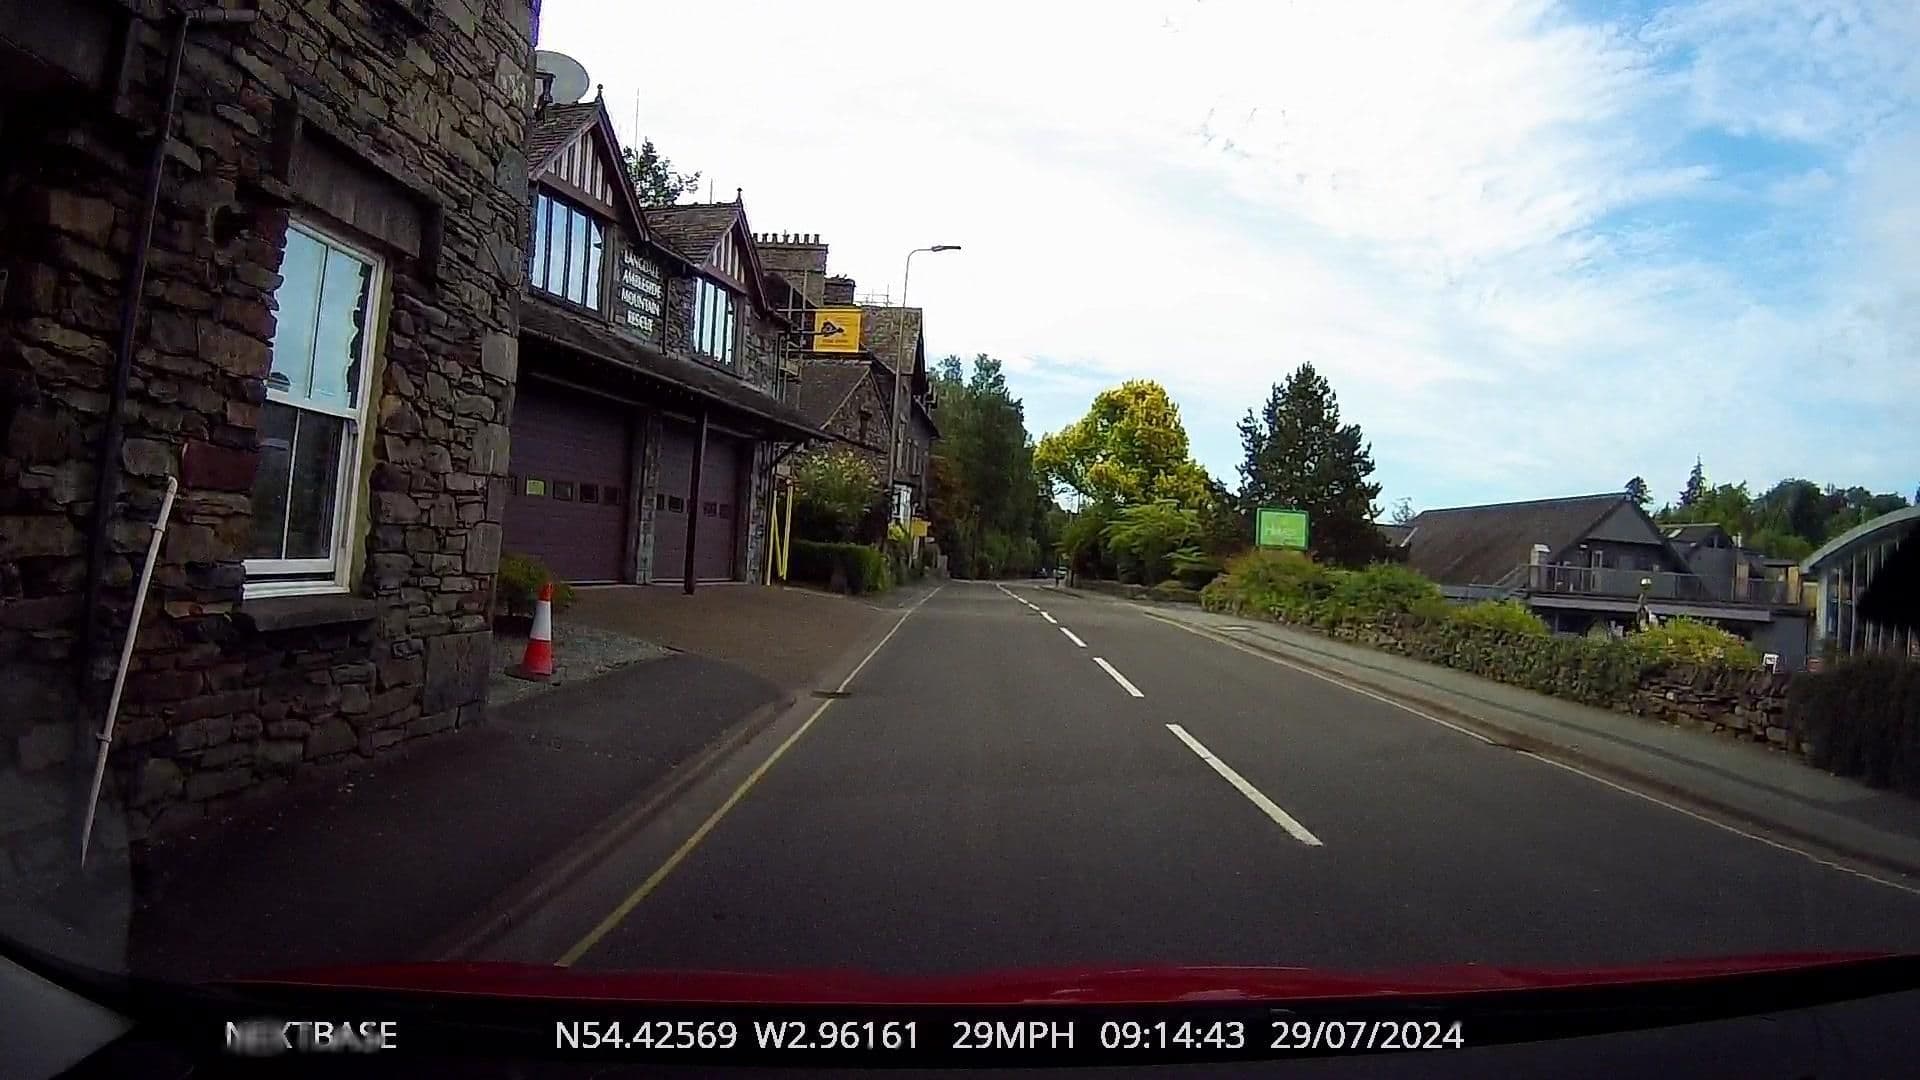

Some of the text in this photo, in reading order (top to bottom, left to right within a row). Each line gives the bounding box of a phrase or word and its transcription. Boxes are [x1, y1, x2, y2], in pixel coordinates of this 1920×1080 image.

[622, 269, 662, 299] AMBLESIDE
[621, 287, 660, 316] MOUNTAIN
[627, 309, 653, 332] RESCUE
